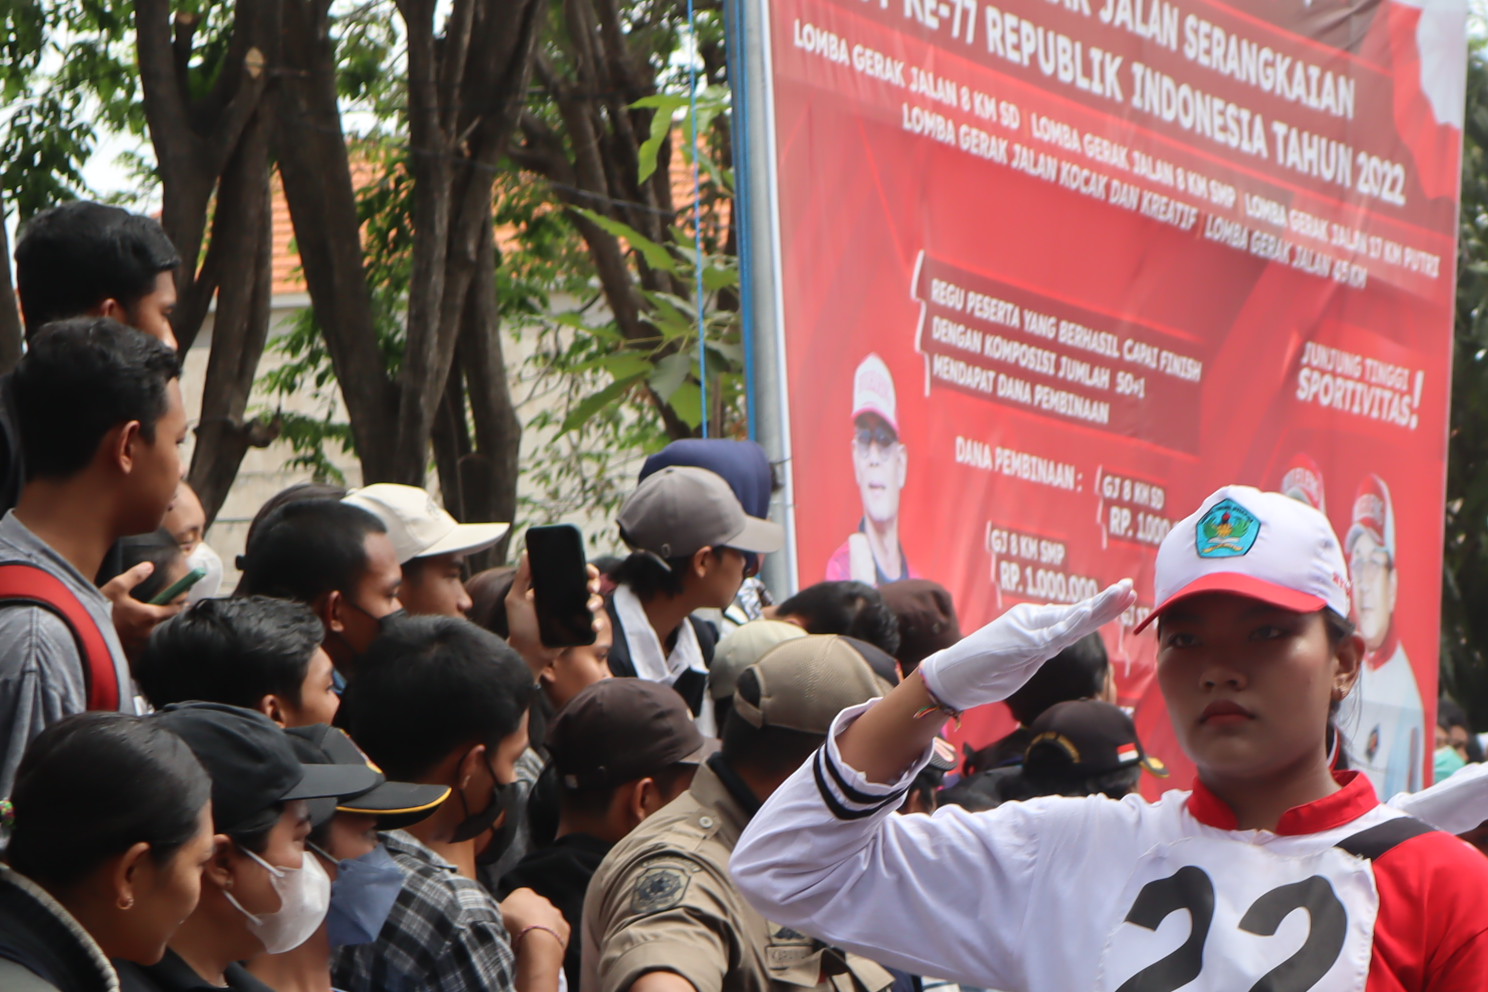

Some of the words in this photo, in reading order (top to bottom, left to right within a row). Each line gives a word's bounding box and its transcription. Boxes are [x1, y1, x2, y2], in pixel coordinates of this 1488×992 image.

[1098, 0, 1180, 53] JALAN
[1182, 13, 1356, 120] SERANGKAIAN
[985, 5, 1125, 103] REPUBLIK
[1131, 61, 1269, 159] INDONESIA
[1271, 119, 1353, 189] TAHUN
[1356, 150, 1407, 207] 2022
[794, 18, 850, 67] LOMBA
[852, 43, 906, 89] GERAK
[909, 65, 958, 108] JALAN
[959, 85, 971, 113] 8
[973, 90, 997, 122] KM
[1000, 99, 1021, 131] SD
[1031, 111, 1082, 154] LOMBA
[1083, 131, 1130, 171] GERAK
[1132, 150, 1175, 187] JALAN
[1175, 167, 1186, 192] 8
[1186, 170, 1208, 200] KM
[1208, 179, 1237, 209] SMP
[1245, 191, 1288, 229] LOMBA
[1288, 208, 1330, 243] GERAK
[1331, 223, 1368, 255] JALAN
[1368, 236, 1384, 260] 17
[1384, 240, 1402, 266] KM
[1403, 247, 1441, 280] PUTRI
[902, 101, 957, 146] LOMBA
[958, 123, 1009, 166] GERAK
[1010, 143, 1059, 183] JALAN
[1058, 160, 1109, 201] KOCAK
[1108, 178, 1141, 212] DAN
[1139, 189, 1199, 232] KREATIF
[1204, 213, 1249, 251] LOMBA
[1249, 228, 1293, 266] GERAK
[1292, 244, 1333, 279] JALAN
[1350, 263, 1369, 290] KM
[931, 277, 964, 310] REGU
[965, 290, 1022, 329] PESERTA
[1023, 307, 1058, 340] YANG
[1057, 319, 1121, 359] BERHASIL
[1122, 338, 1160, 370] CAPAI
[1159, 350, 1203, 384] FINISH
[931, 315, 983, 351] DENGAN
[983, 333, 1057, 377] KOMPOSISI
[1057, 355, 1112, 390] JUMLAH
[1115, 370, 1146, 400] 50+1
[932, 352, 997, 395] MENDAPAT
[996, 372, 1033, 404] DANA
[1033, 383, 1111, 426] PEMBINAAN
[1296, 366, 1425, 430] SPORTIVITAS!
[1300, 340, 1363, 379] JUNJUNG
[1364, 356, 1410, 391] TINGGI
[955, 434, 993, 471] DANA
[995, 445, 1076, 491] PEMBINAAN
[1102, 474, 1121, 500] GJ
[1122, 479, 1132, 502] 8
[1133, 481, 1151, 507] KM
[1150, 485, 1165, 511] SD
[990, 528, 1009, 554] GJ
[1010, 533, 1018, 556] 8
[1019, 536, 1039, 560] KM
[1039, 540, 1066, 566] SMP
[1109, 505, 1133, 539] RP.
[1000, 559, 1023, 592] RP.
